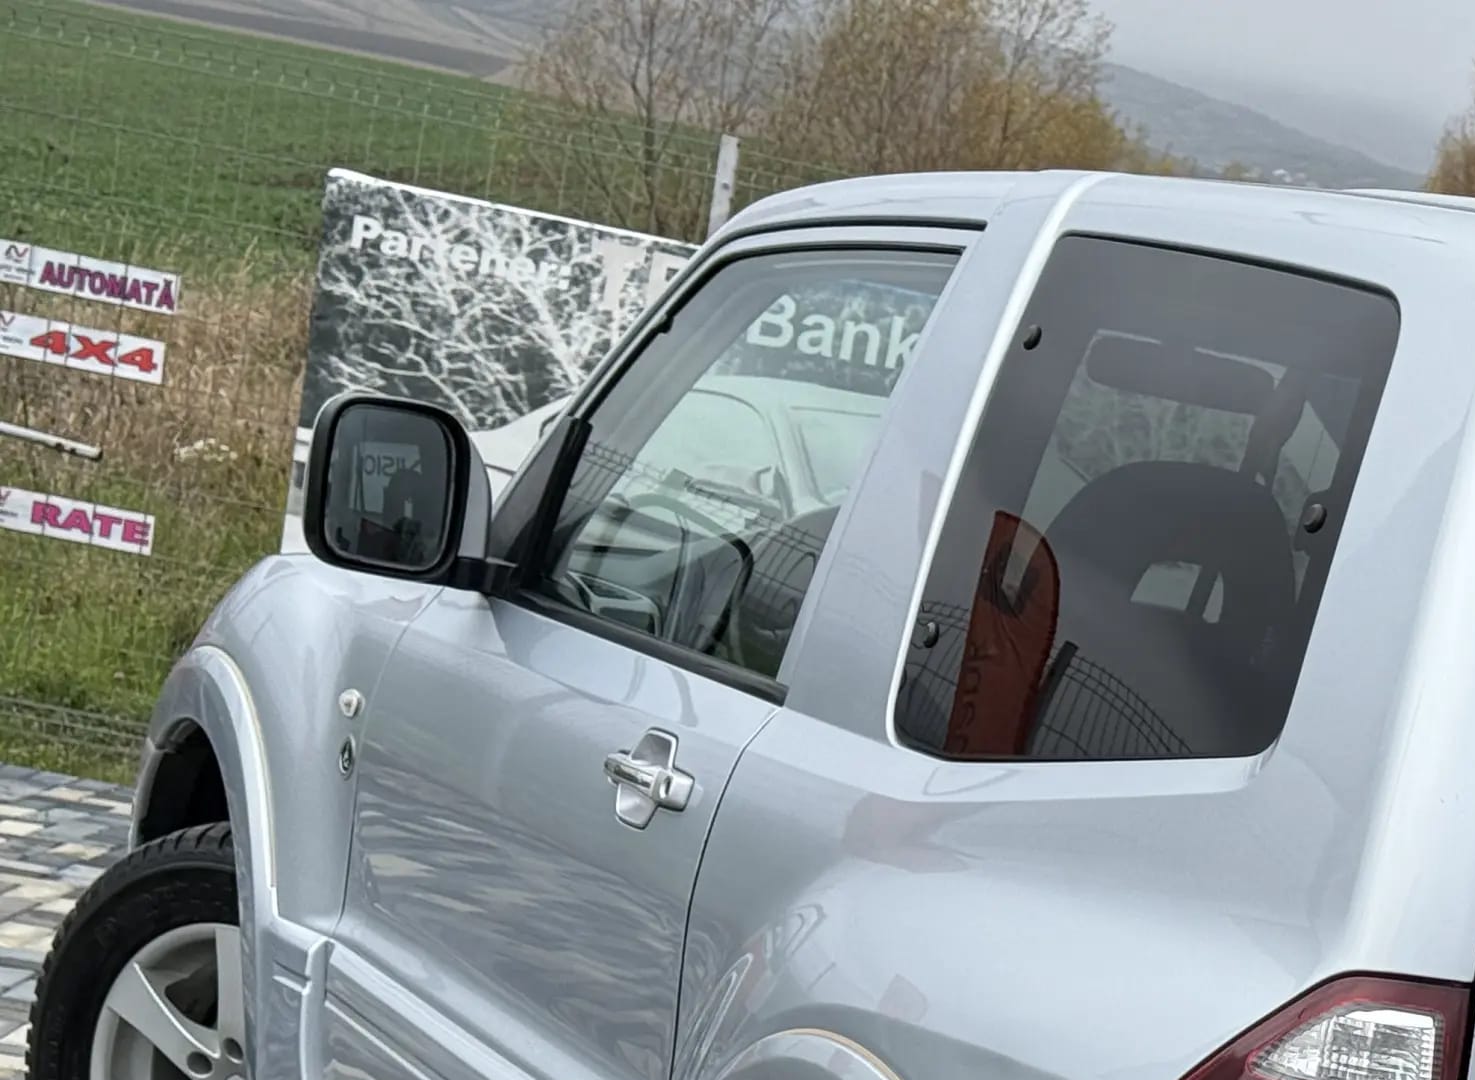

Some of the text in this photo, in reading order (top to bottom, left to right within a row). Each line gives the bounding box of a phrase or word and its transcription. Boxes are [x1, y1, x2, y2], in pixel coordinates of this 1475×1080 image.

[350, 214, 572, 290] Partener:
[38, 260, 175, 311] AUTOMATĂ
[746, 294, 921, 370] Bank
[30, 501, 150, 547] RATE
